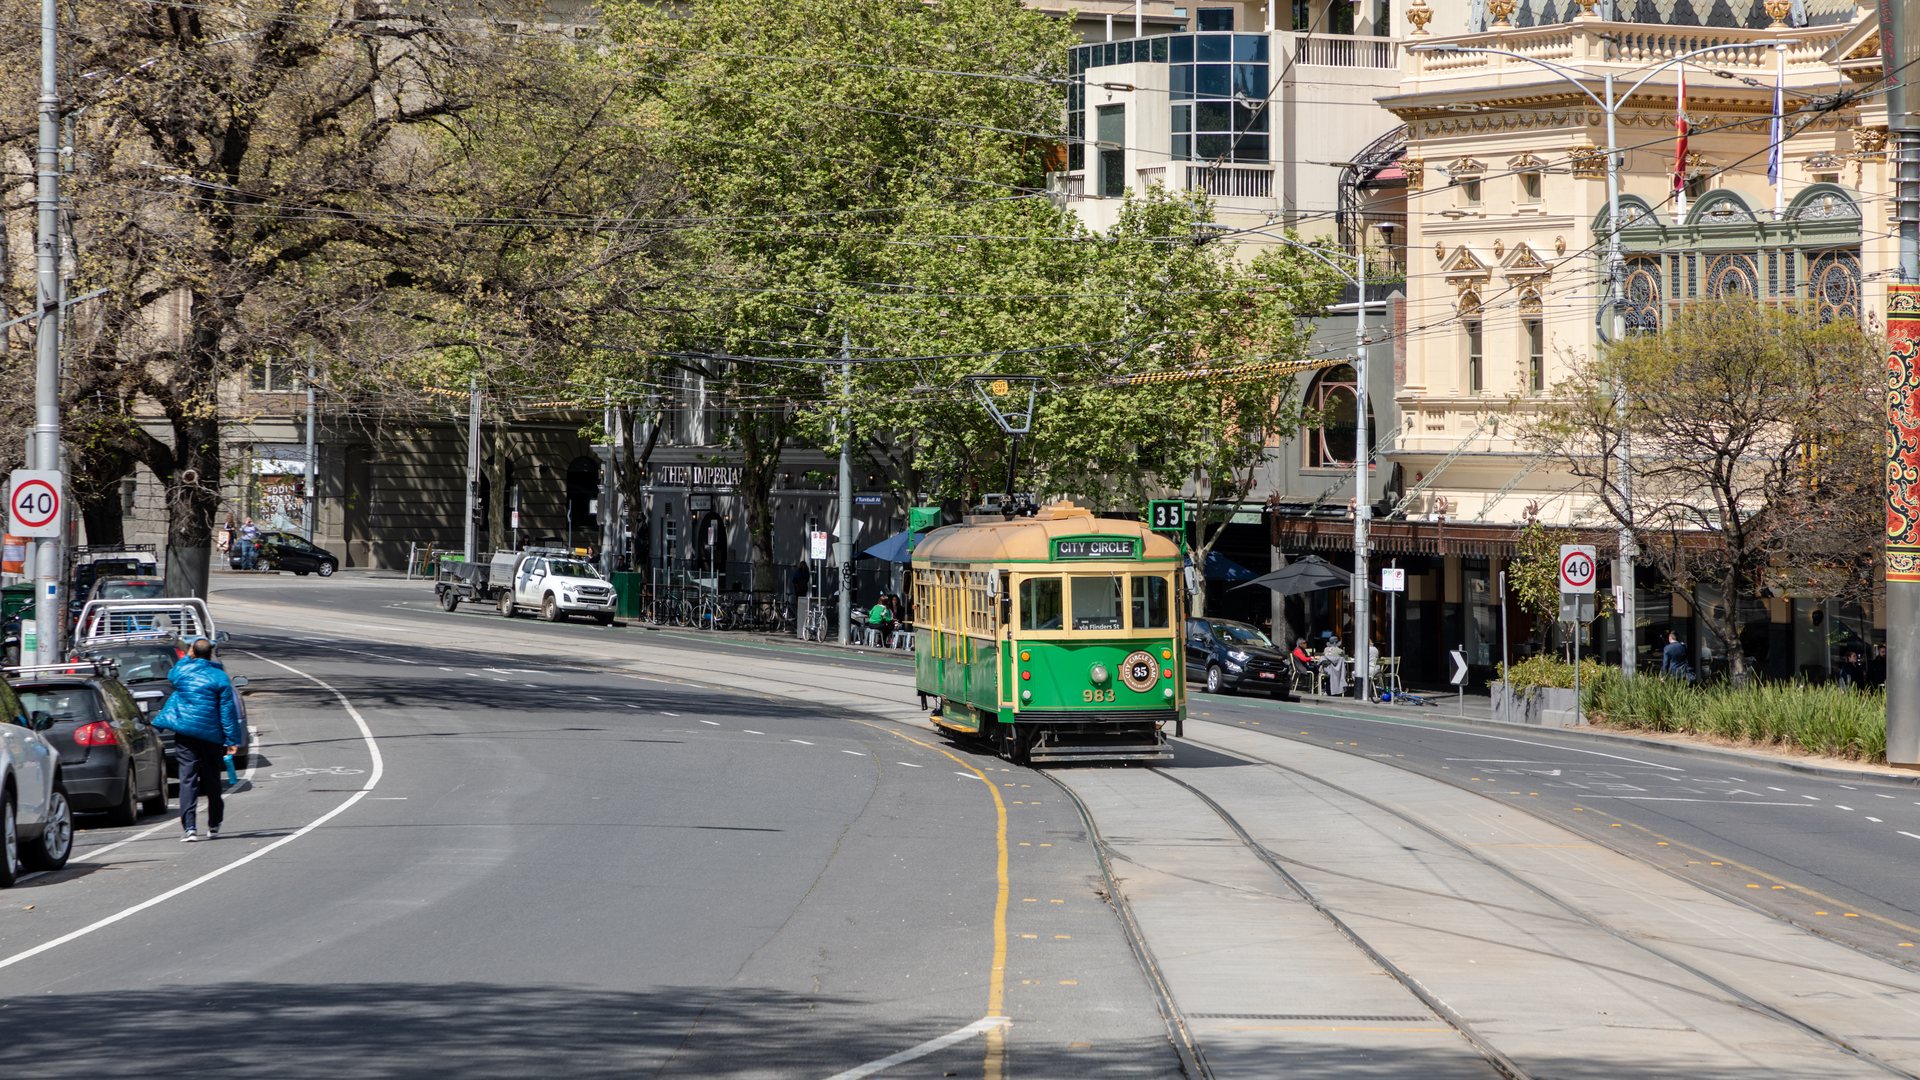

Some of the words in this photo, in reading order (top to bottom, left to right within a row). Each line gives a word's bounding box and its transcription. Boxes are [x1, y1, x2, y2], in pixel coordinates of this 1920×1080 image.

[662, 466, 684, 483] THE
[19, 493, 52, 514] 40
[1157, 506, 1179, 526] 35
[1060, 542, 1085, 553] CITY
[1090, 542, 1129, 553] CIRCLE
[1567, 561, 1589, 577] 40
[1129, 654, 1149, 664] CIRCLE
[1148, 659, 1156, 678] TRAM
[1134, 666, 1147, 677] 35
[1083, 689, 1115, 702] 983
